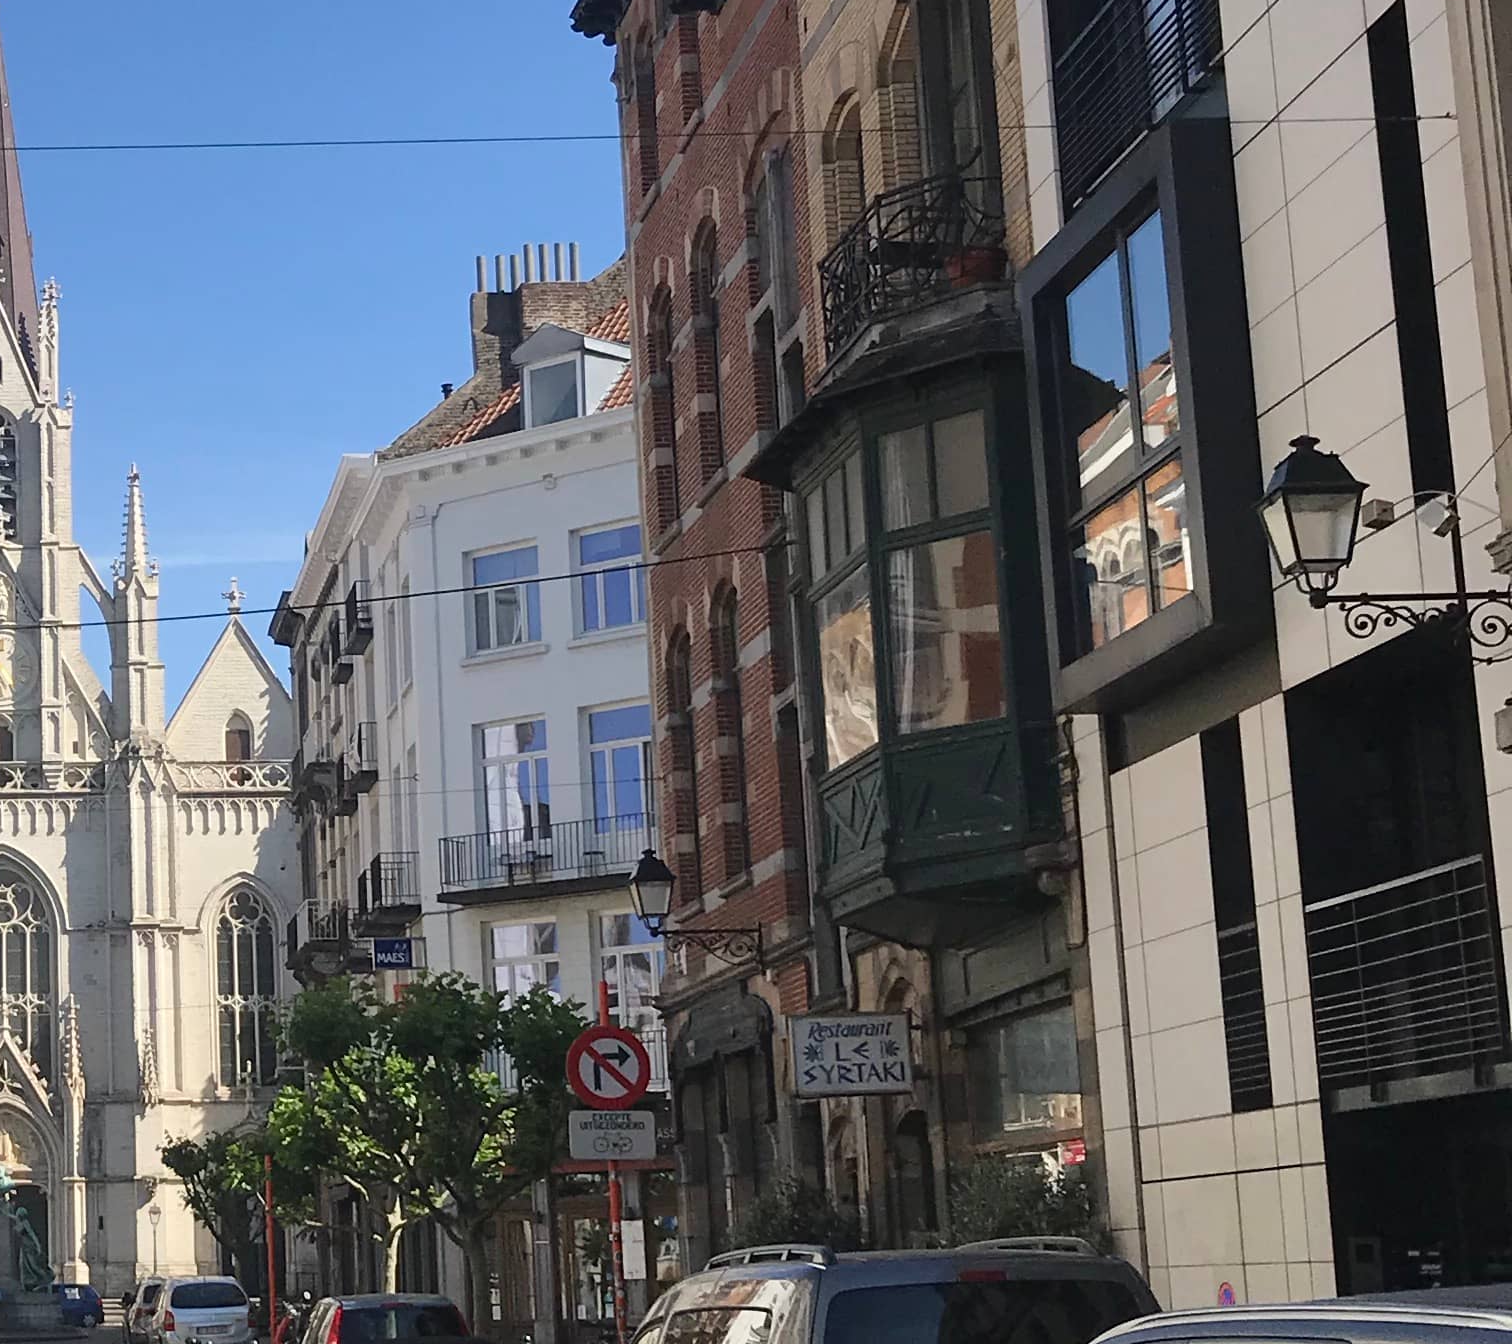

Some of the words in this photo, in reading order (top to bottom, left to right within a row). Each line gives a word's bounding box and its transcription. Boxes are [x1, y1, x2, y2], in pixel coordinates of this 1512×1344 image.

[376, 952, 406, 964] MAES
[807, 1021, 893, 1043] Restaurant
[834, 1041, 870, 1062] LE
[803, 1061, 906, 1086] SYRTAKI
